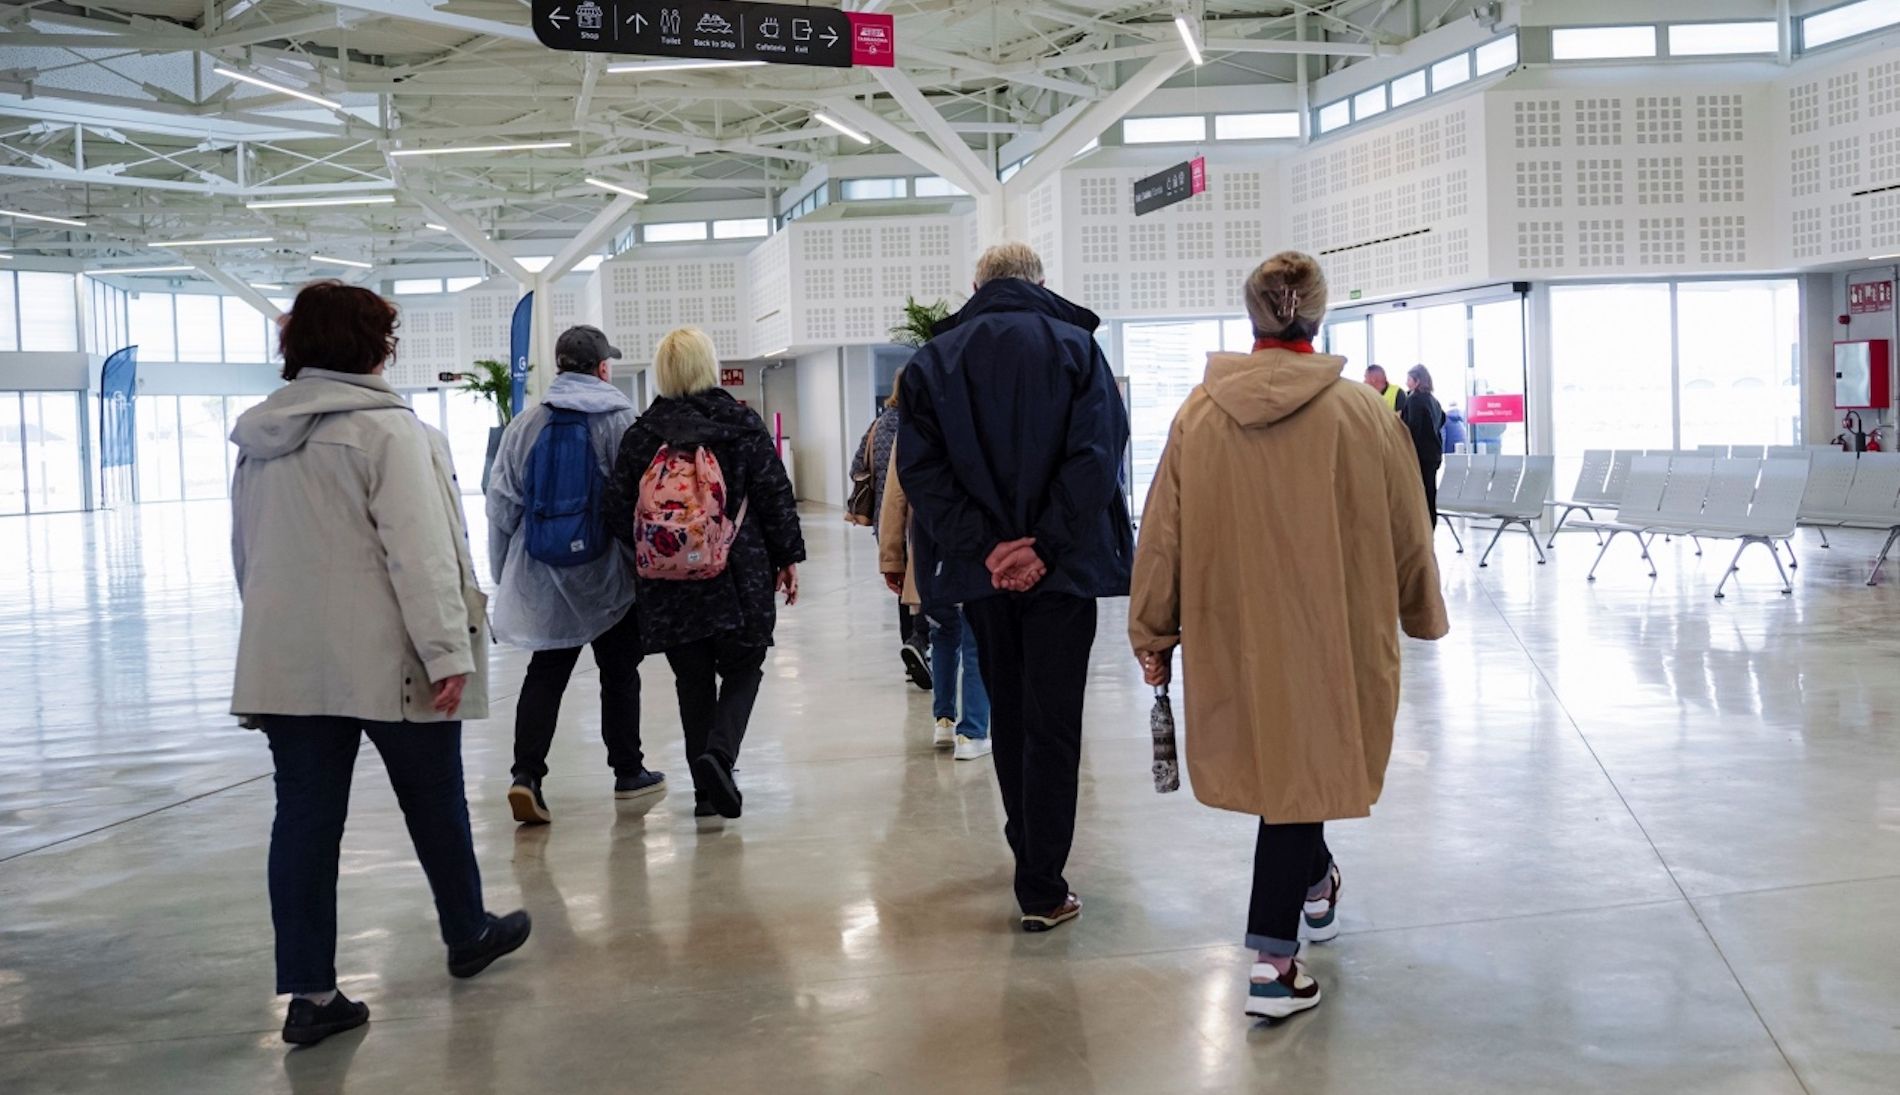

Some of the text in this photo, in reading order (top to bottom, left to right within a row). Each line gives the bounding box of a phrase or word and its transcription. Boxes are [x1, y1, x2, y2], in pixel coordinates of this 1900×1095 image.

[581, 31, 599, 40] Shop
[661, 36, 681, 45] Toilet
[693, 39, 736, 49] Back to Ship
[756, 43, 786, 52] Cafeteria
[795, 45, 808, 53] Exit
